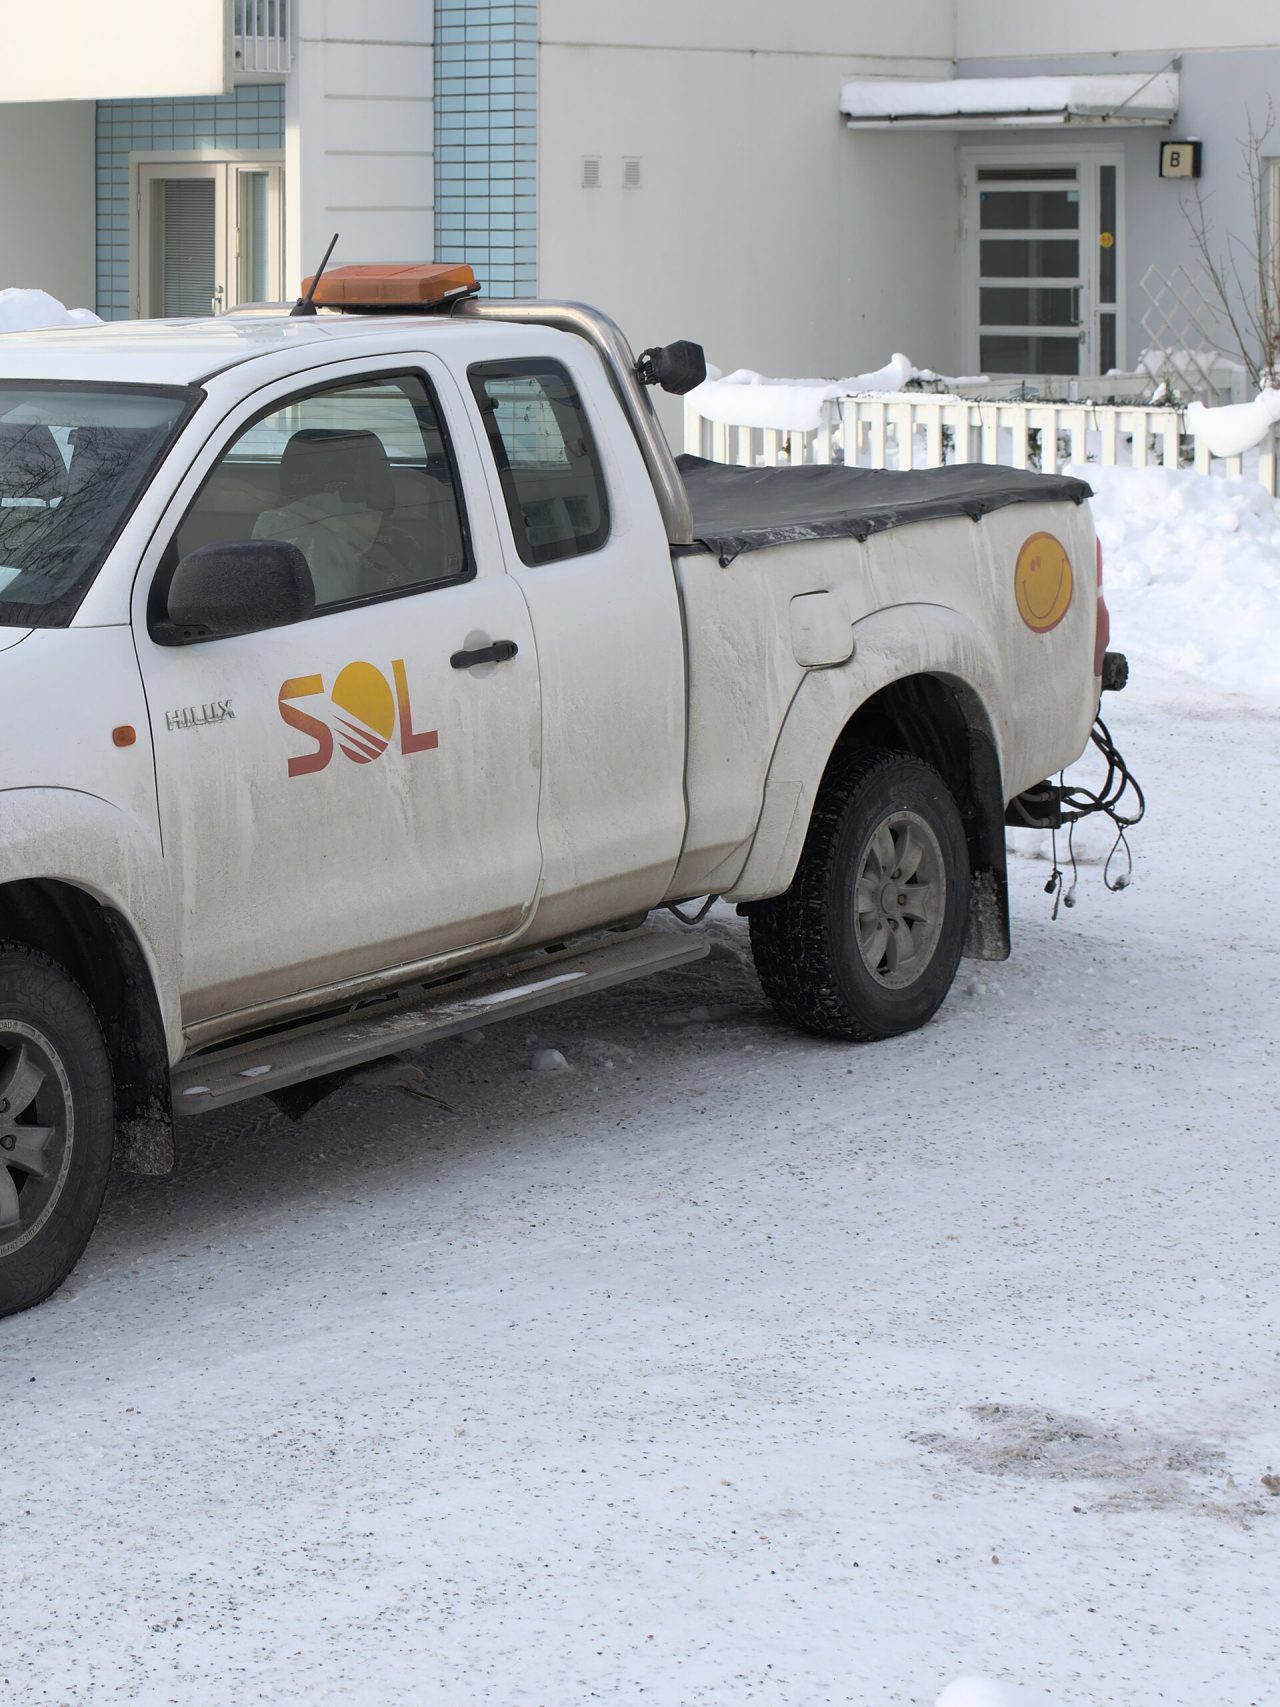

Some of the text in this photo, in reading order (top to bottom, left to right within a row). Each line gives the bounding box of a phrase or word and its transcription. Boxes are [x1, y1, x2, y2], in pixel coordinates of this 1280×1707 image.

[1170, 151, 1181, 168] B
[166, 699, 236, 731] HILUX
[278, 659, 438, 778] SOL
